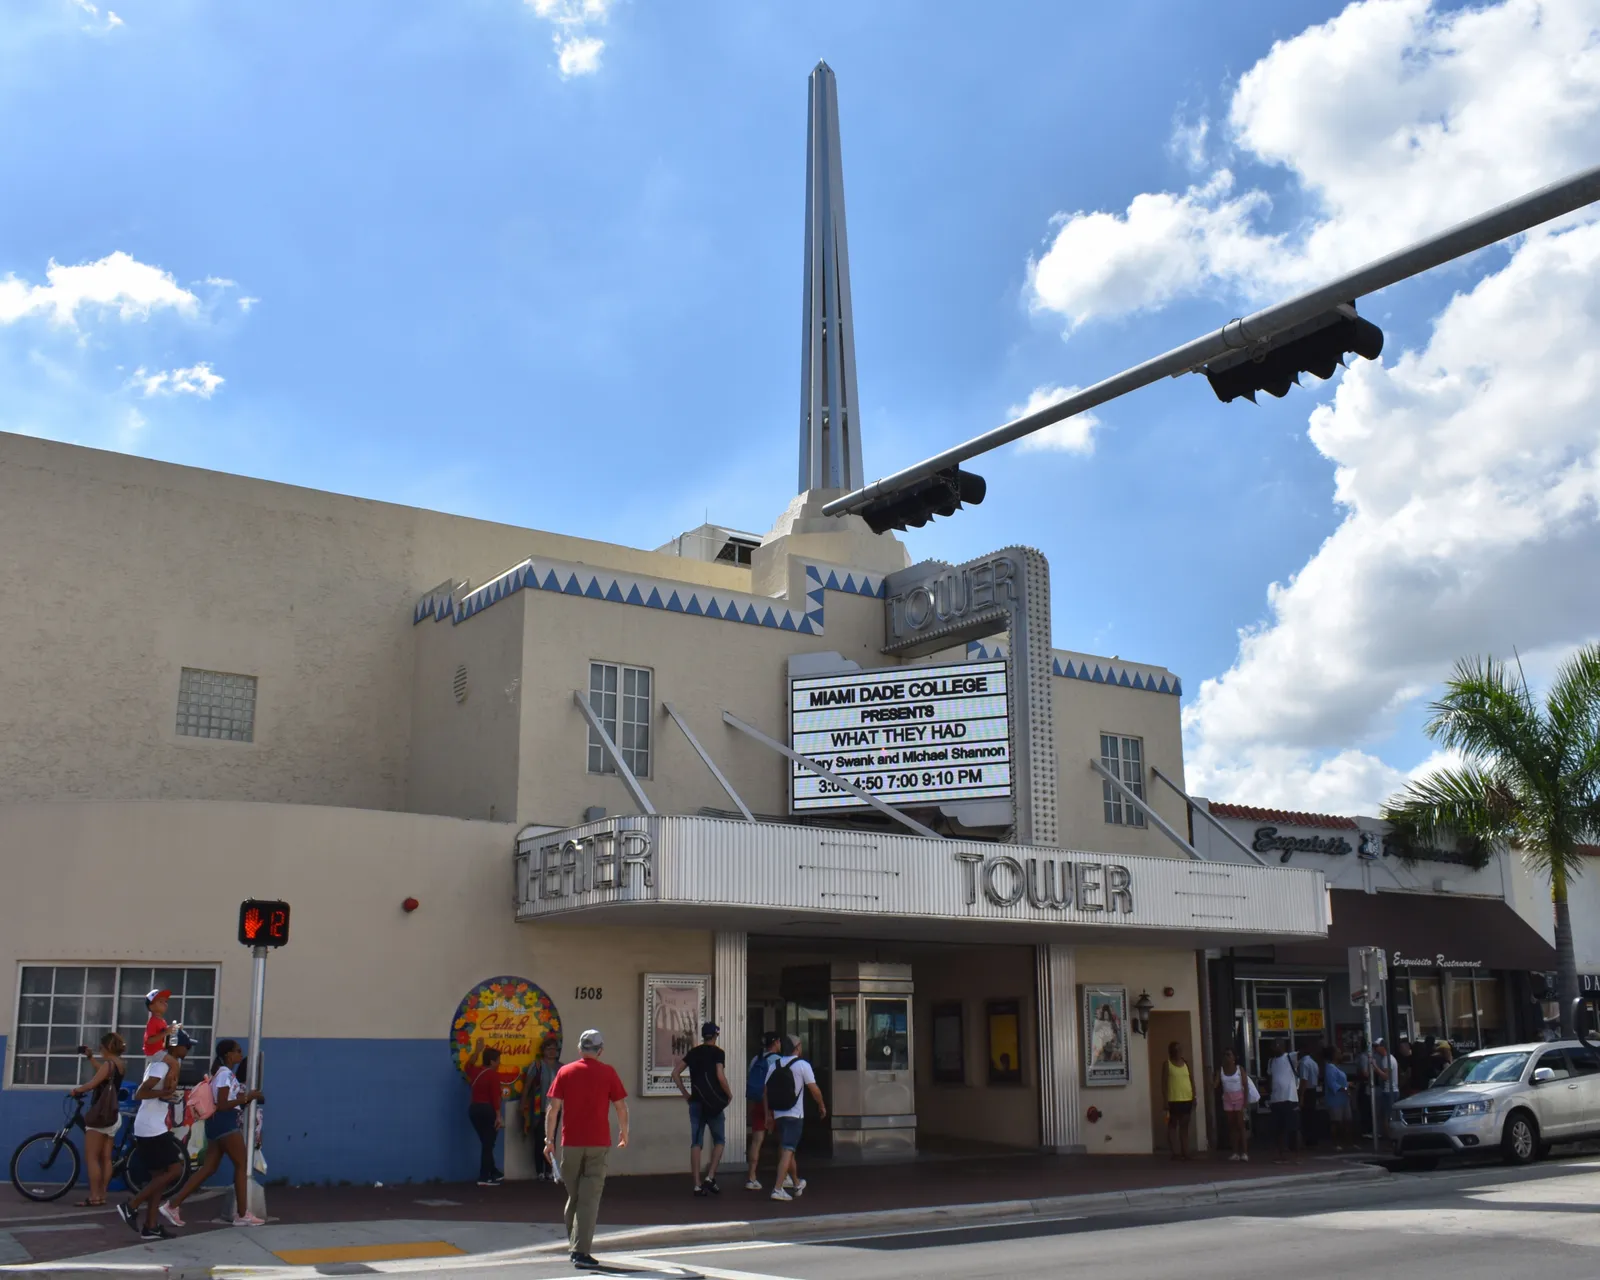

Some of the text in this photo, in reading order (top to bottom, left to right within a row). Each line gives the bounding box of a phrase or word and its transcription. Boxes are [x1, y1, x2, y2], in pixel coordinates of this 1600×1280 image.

[886, 556, 1019, 637] TOWER
[810, 677, 987, 707] MIAMI DADE COLLEGE
[860, 705, 934, 723] PRESENTS
[831, 723, 966, 747] WHAT THEY HAD
[836, 756, 874, 768] Swank
[877, 752, 899, 765] and
[902, 748, 948, 763] Michael
[951, 746, 1005, 760] Shannon
[852, 774, 883, 790] 4:50
[888, 773, 918, 788] 7:00
[922, 771, 954, 786] 9:10
[958, 769, 982, 783] PM
[955, 852, 1133, 914] TOWER
[1393, 952, 1482, 968] Exquisito Restaurant
[575, 987, 603, 1000] 1508
